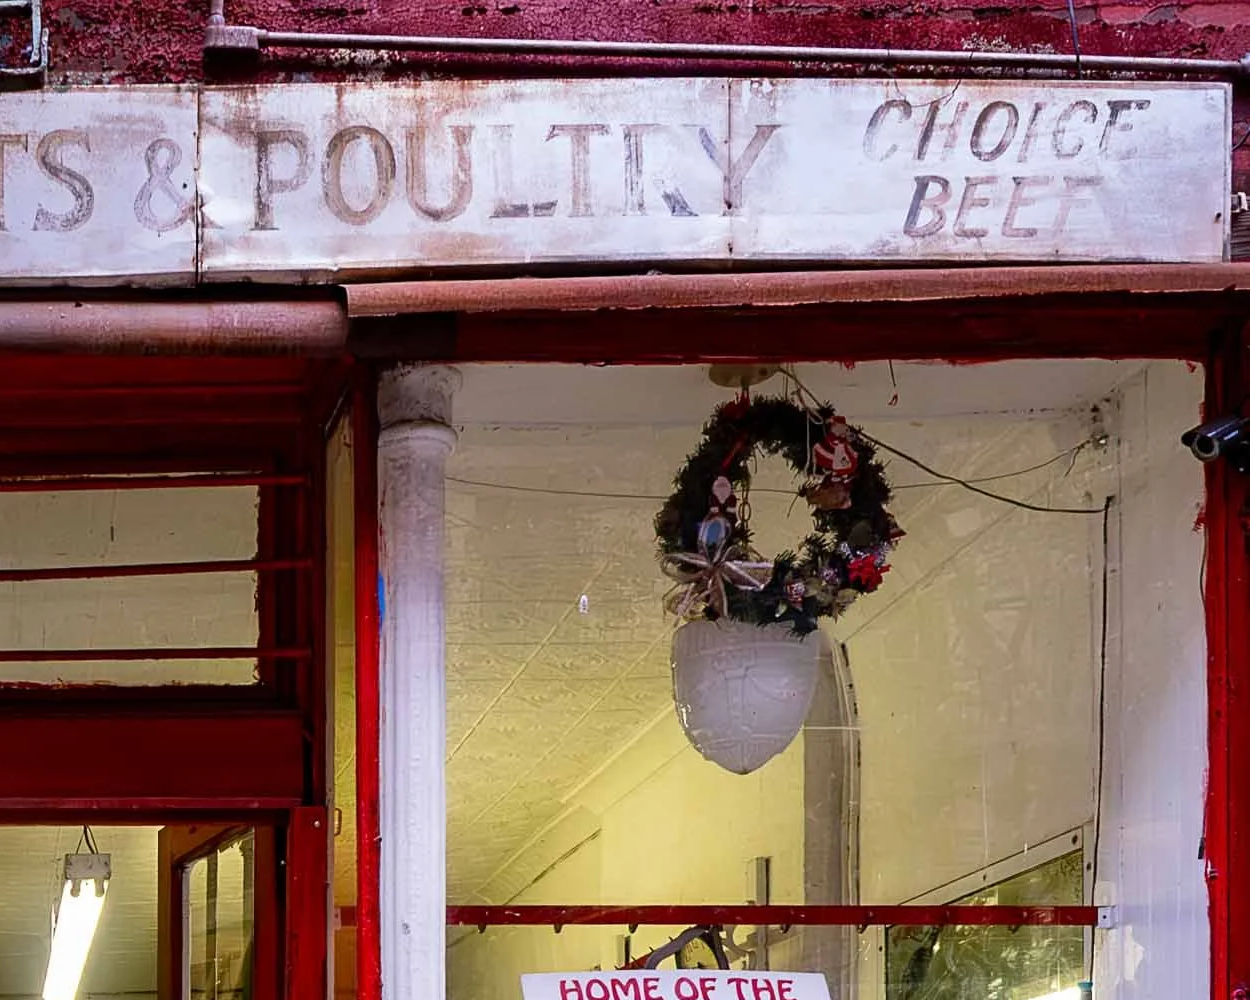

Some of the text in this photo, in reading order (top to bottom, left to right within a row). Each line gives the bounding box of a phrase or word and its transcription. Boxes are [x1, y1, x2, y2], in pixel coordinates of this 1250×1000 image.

[862, 98, 1152, 163] CHOICE
[133, 136, 224, 234] &
[248, 124, 783, 232] POULTRY
[903, 174, 1104, 239] BEEF
